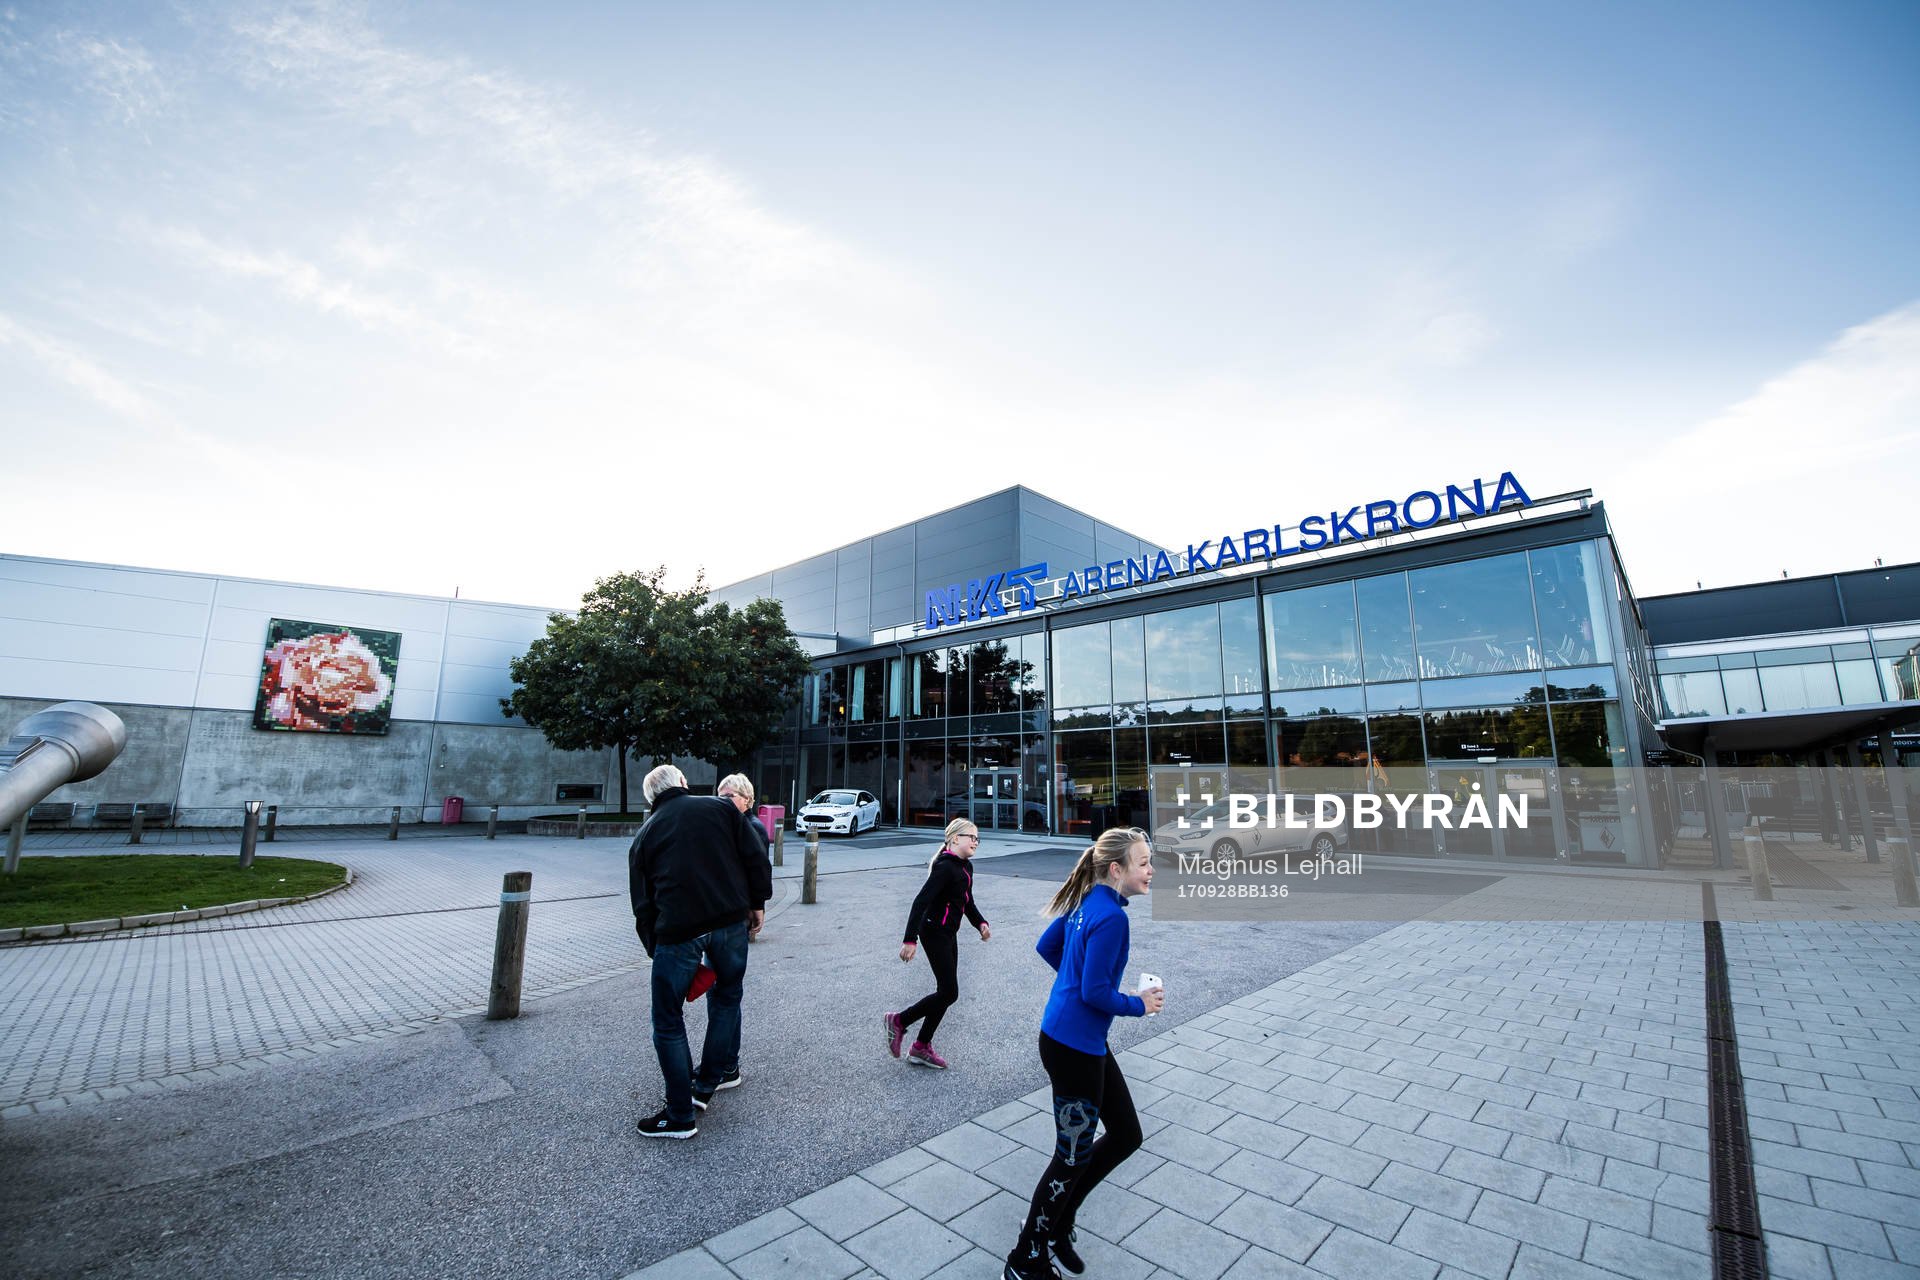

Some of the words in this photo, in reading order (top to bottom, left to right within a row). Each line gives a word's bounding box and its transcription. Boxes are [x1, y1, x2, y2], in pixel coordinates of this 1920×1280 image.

[925, 561, 1048, 630] NKT
[1061, 549, 1176, 600] ARENA
[1187, 471, 1533, 575] KARLSKRONA
